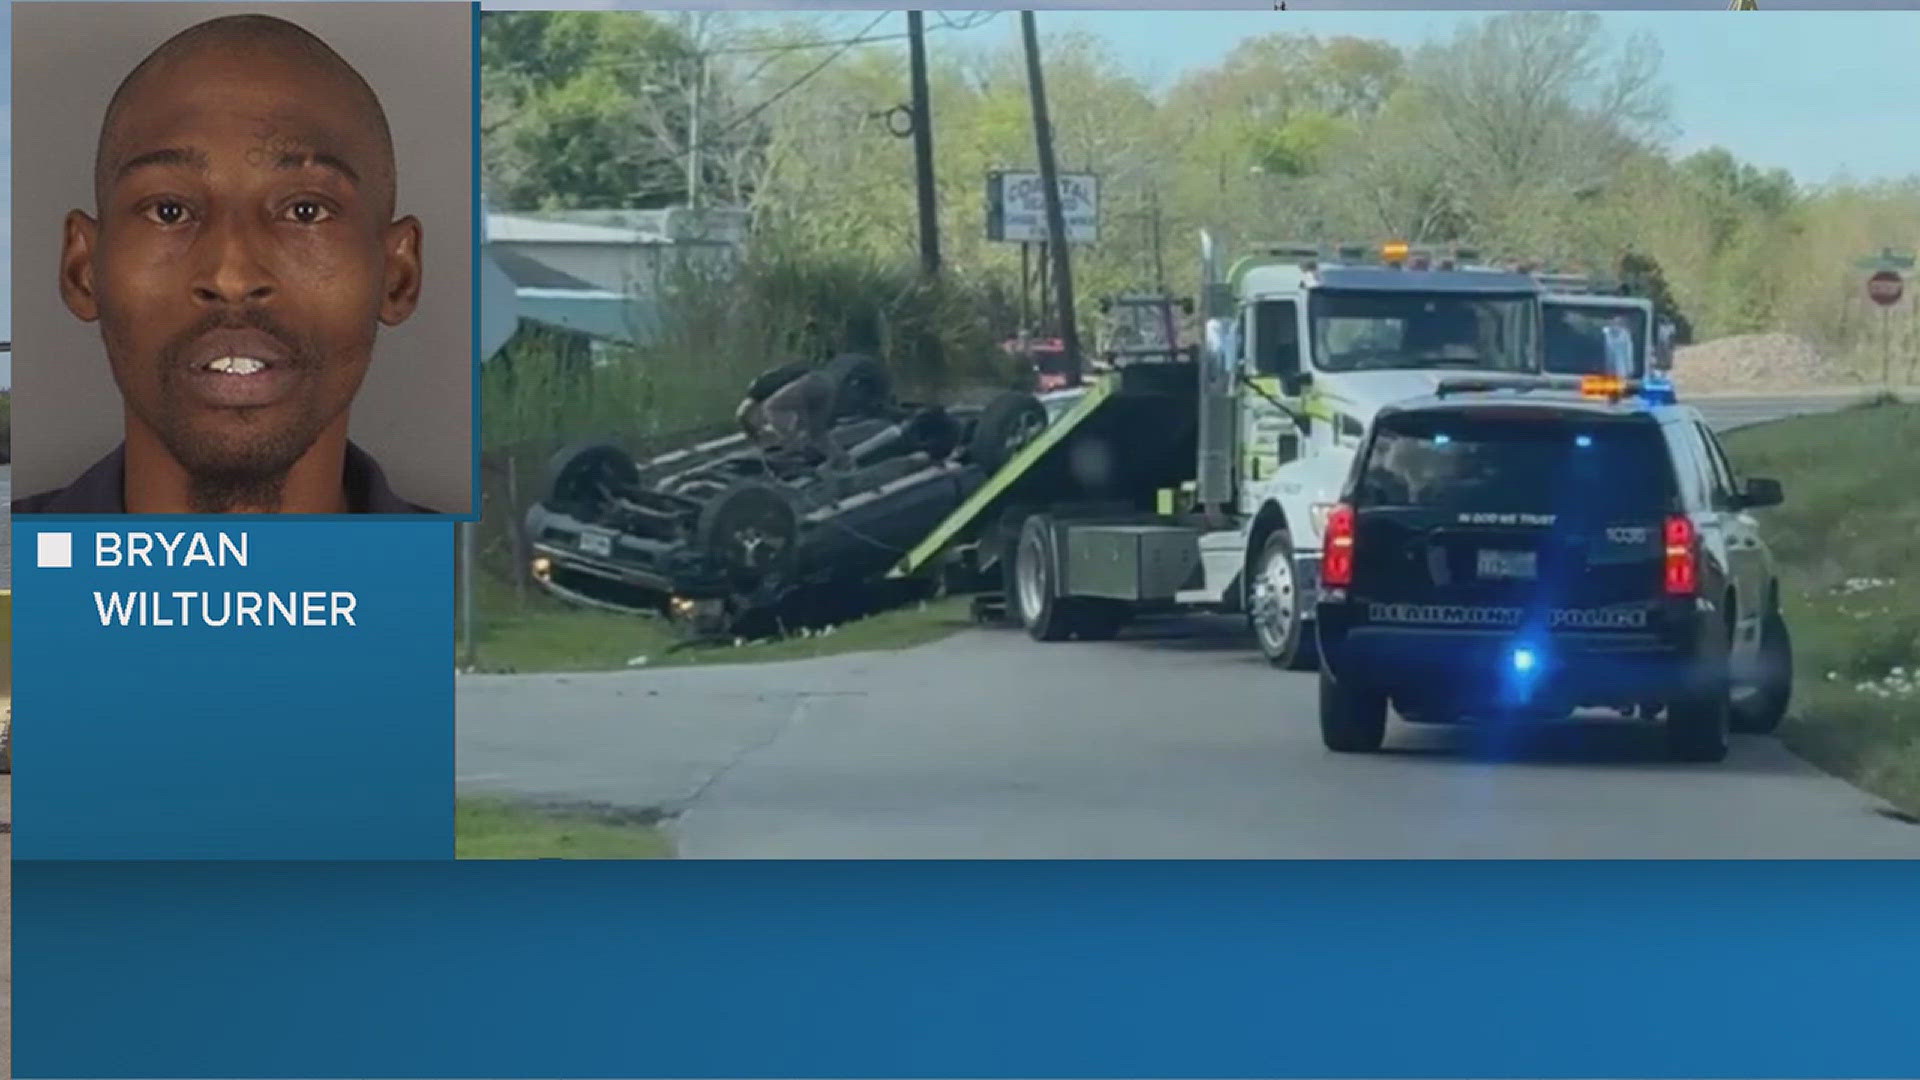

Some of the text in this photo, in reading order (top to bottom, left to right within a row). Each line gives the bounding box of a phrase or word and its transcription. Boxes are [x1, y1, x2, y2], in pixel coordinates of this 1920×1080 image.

[1458, 513, 1557, 527] IN GOD WE TRUST
[1369, 603, 1647, 628] BEAUMONT POLICE
